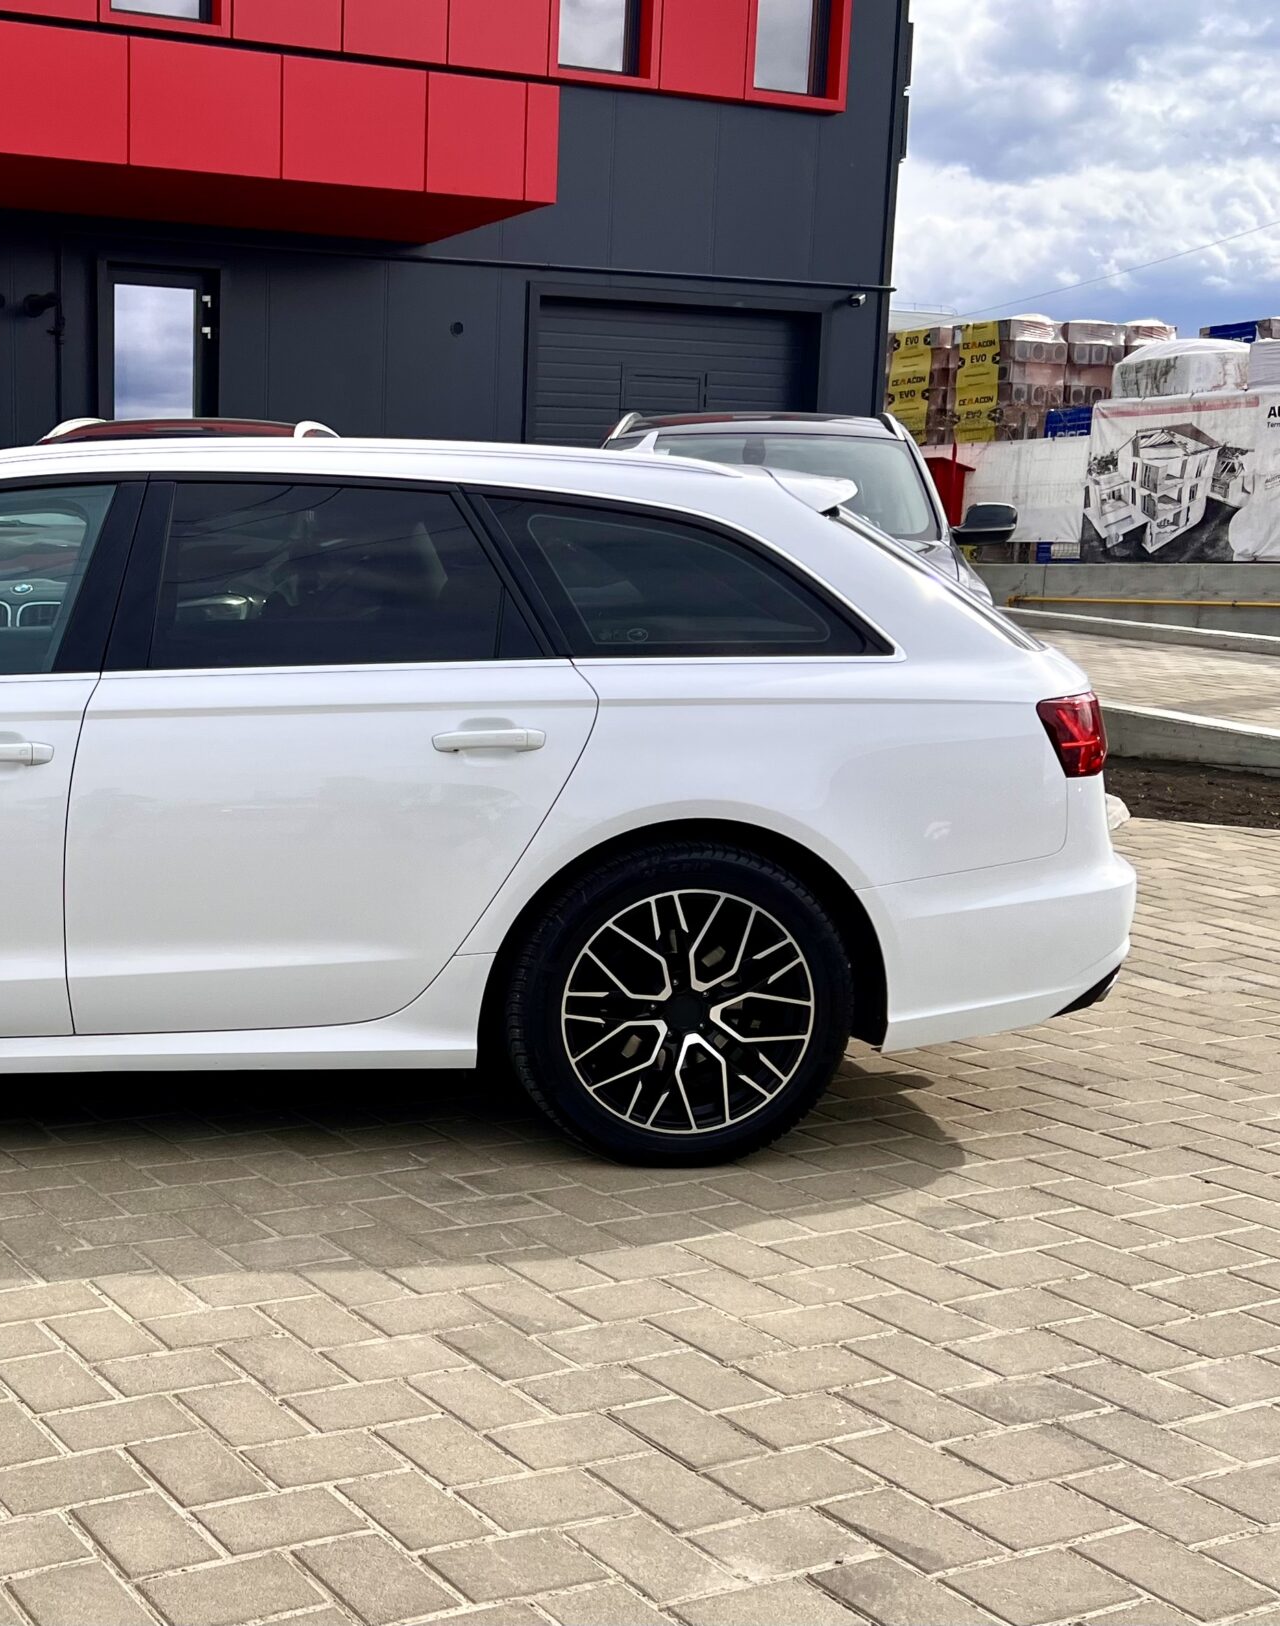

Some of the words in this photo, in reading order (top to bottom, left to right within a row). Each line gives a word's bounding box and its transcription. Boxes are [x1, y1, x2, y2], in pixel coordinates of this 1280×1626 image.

[905, 336, 919, 346] EVO
[970, 354, 987, 364] EVO
[899, 390, 916, 399] EVO
[1267, 406, 1280, 419] A
